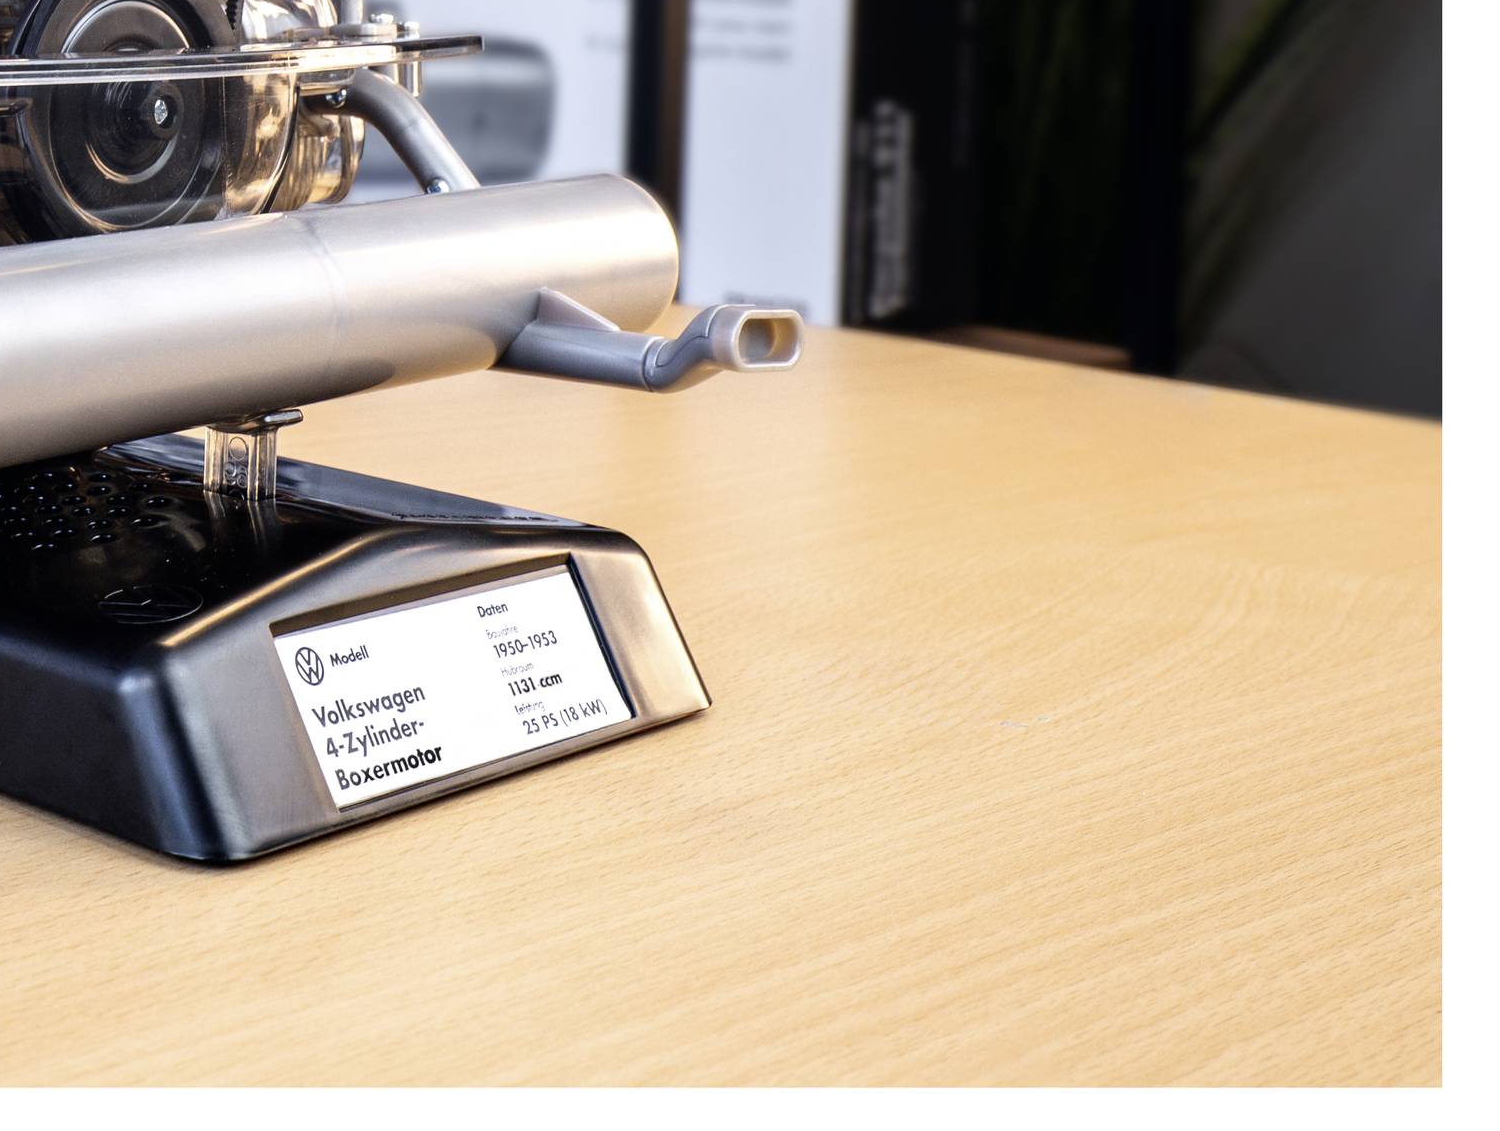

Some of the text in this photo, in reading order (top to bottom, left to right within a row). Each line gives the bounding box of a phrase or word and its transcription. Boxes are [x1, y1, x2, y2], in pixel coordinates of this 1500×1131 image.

[476, 603, 509, 618] Daten
[329, 644, 370, 667] Modell
[508, 673, 563, 696] 1131 ccm
[311, 686, 426, 728] Volkswagen
[522, 698, 608, 735] 25 PS (18 kW)
[326, 718, 425, 758] 4-Zylinder-
[334, 746, 442, 791] Boxermotor
